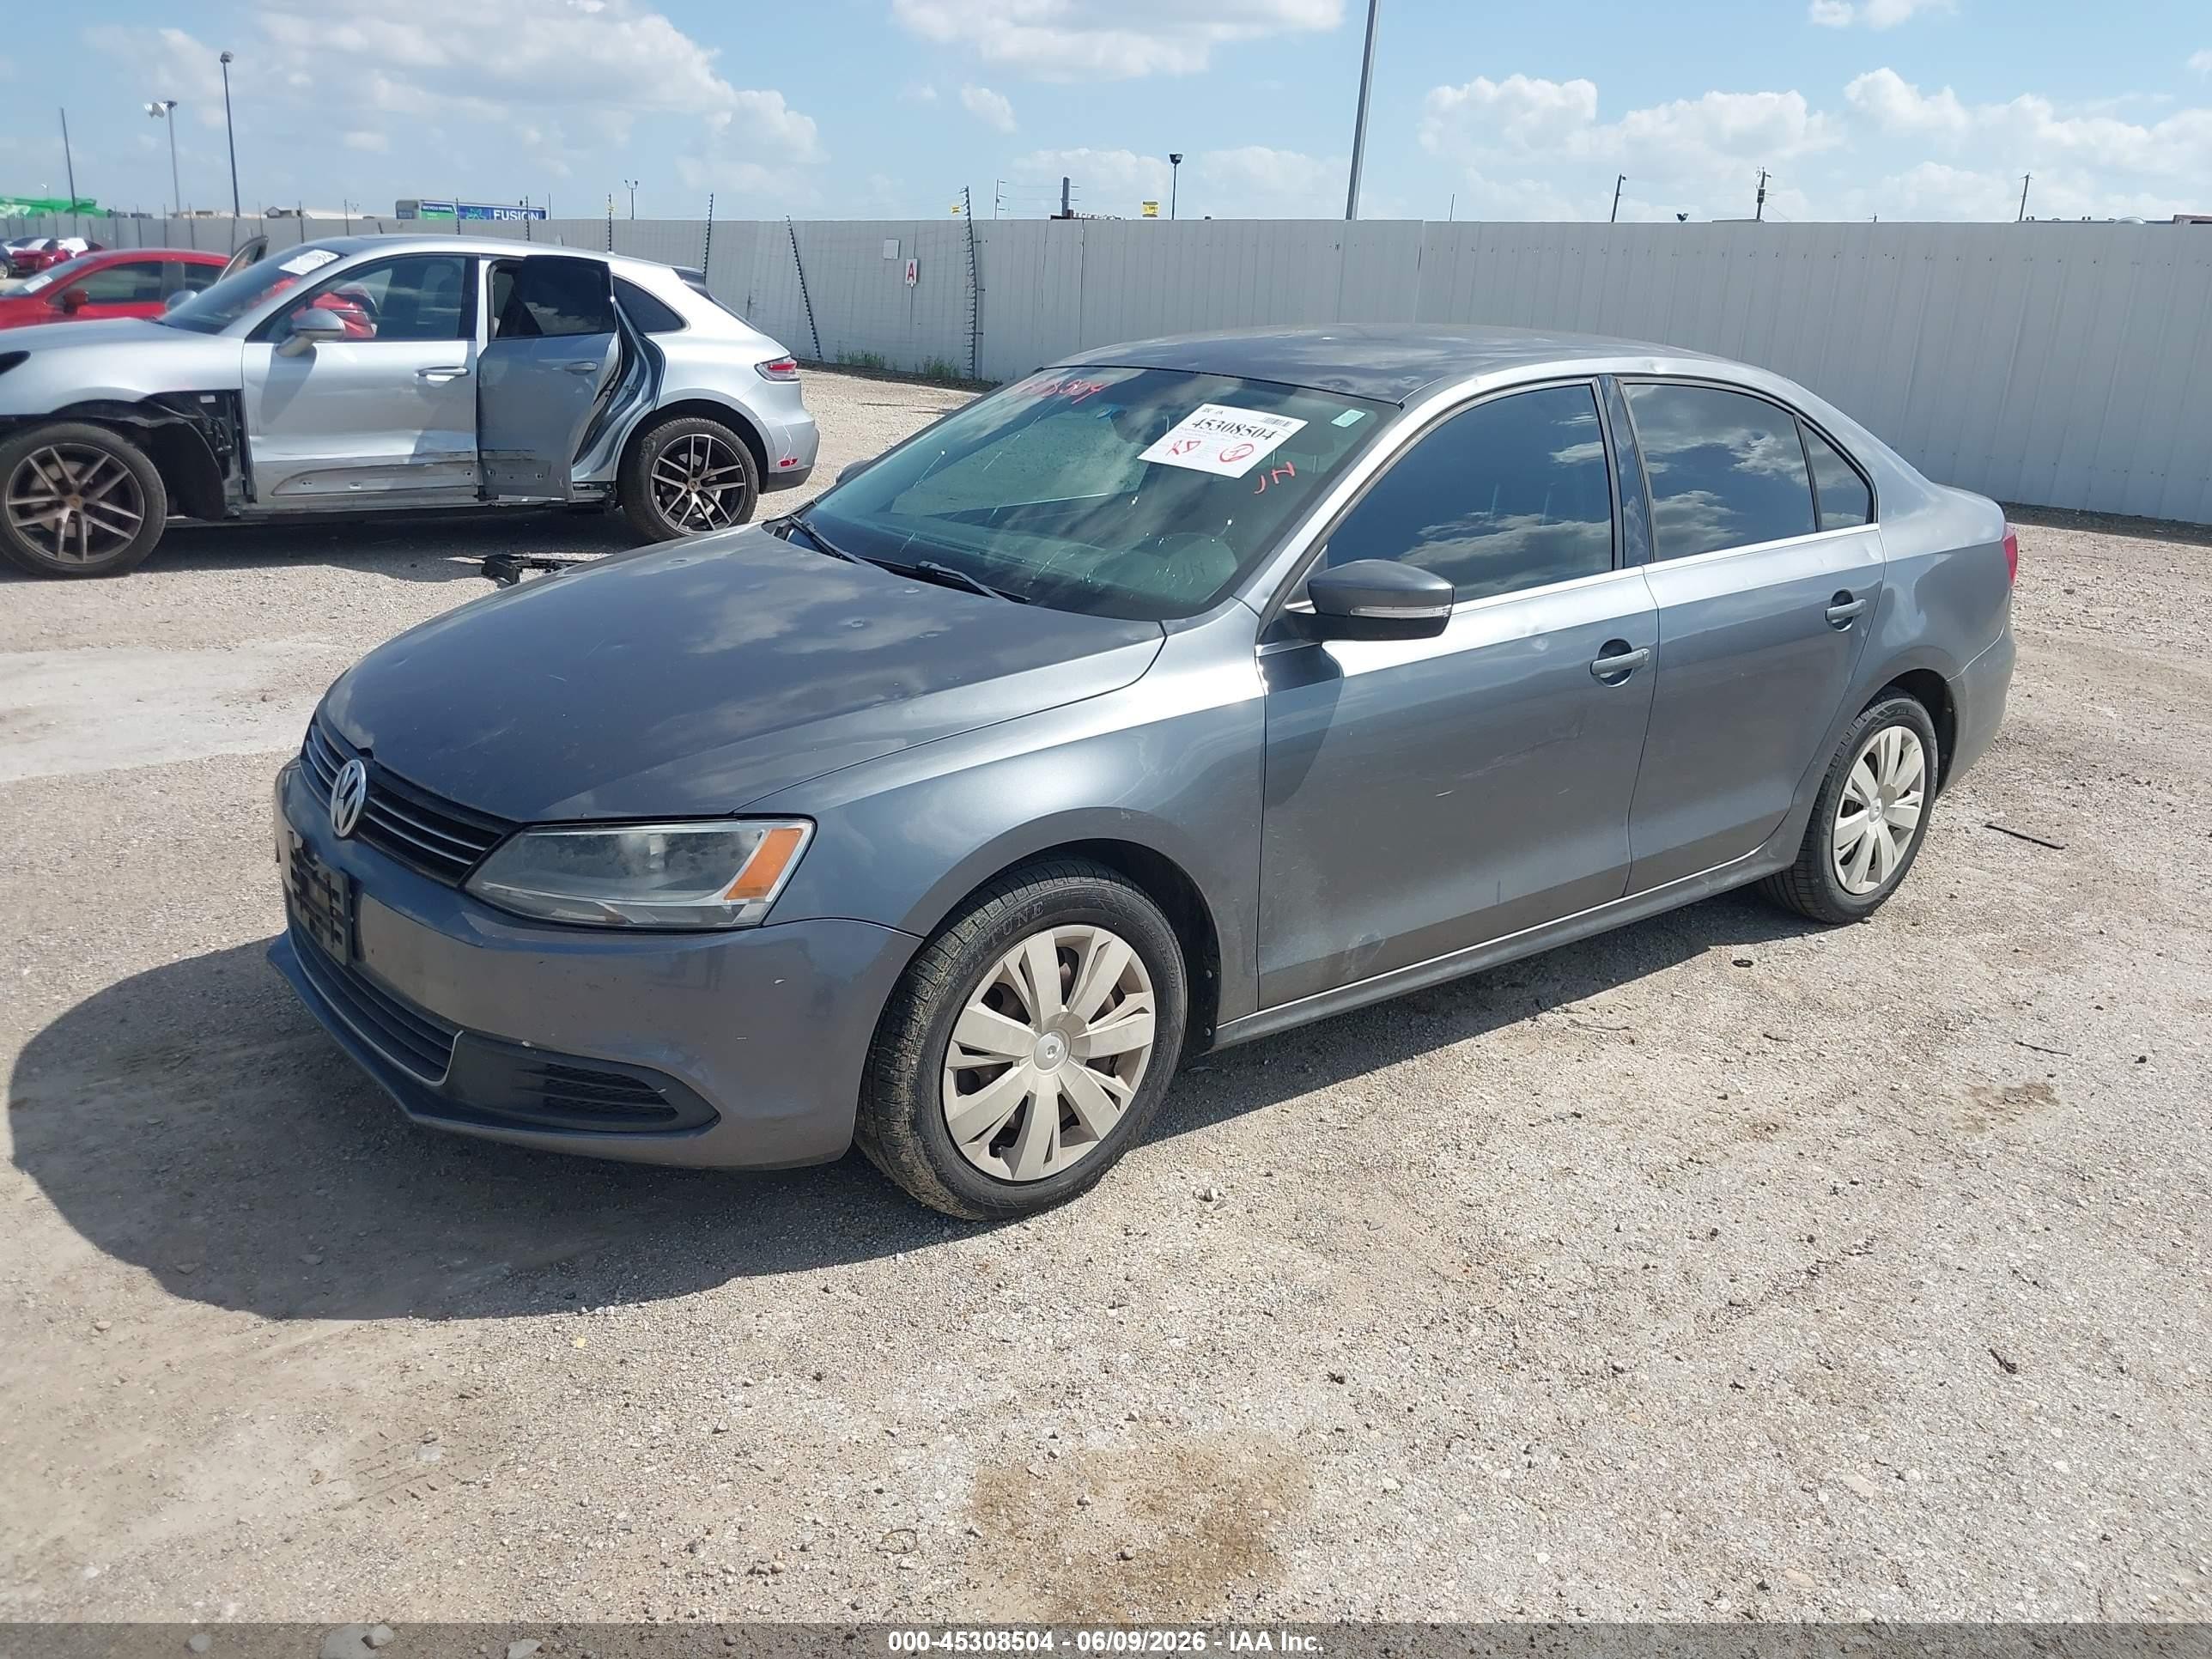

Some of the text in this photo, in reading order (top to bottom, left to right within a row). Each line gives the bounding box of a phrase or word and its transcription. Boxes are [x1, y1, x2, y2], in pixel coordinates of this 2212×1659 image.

[494, 210, 538, 220] FUSION
[906, 262, 915, 282] A
[1192, 417, 1278, 441] 45308504
